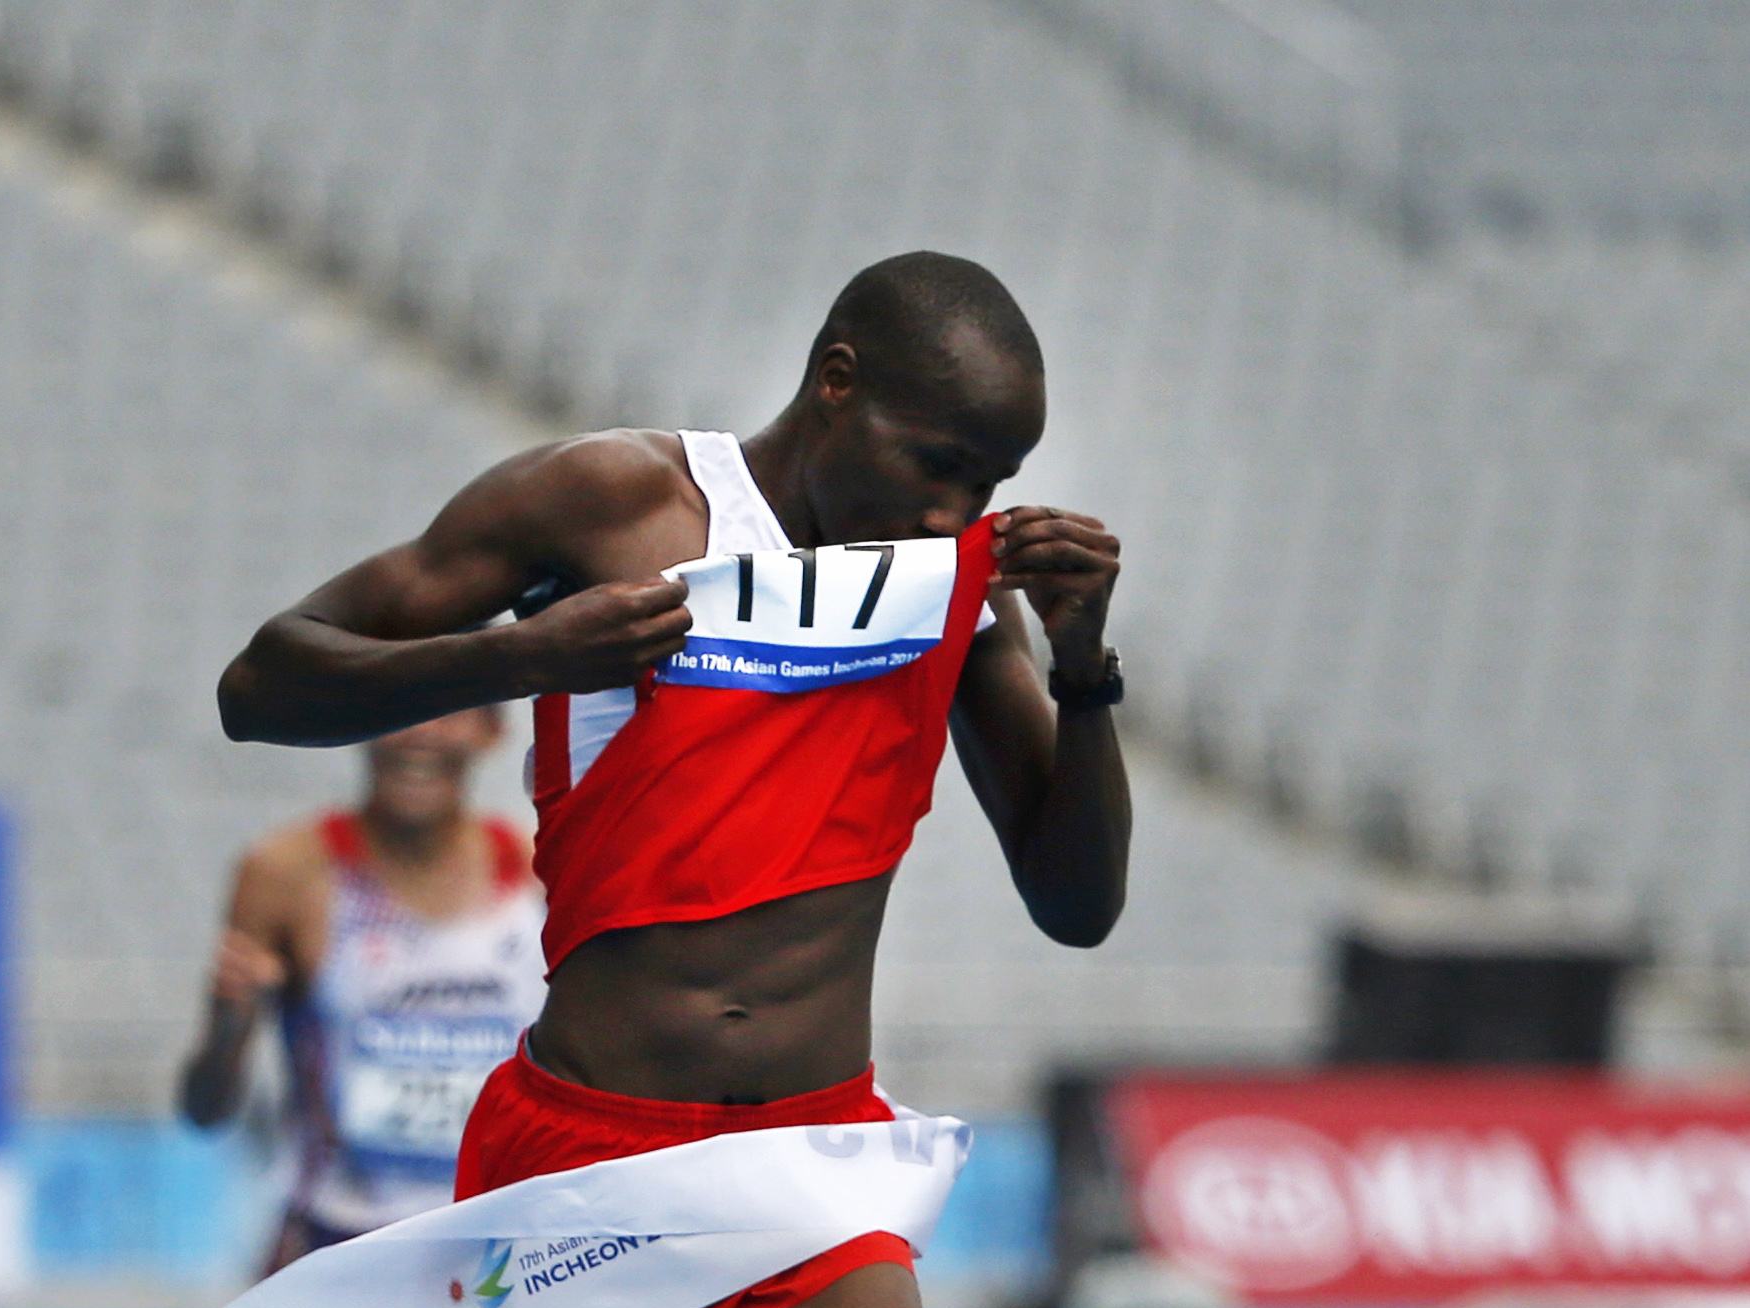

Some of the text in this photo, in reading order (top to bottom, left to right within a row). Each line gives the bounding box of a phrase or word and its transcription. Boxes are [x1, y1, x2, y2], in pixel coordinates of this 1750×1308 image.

[735, 545, 894, 630] 117
[700, 653, 731, 672] 17th
[732, 656, 777, 676] Asian
[780, 660, 830, 677] Games
[519, 1235, 589, 1271] 17th Asian
[523, 1235, 640, 1296] INCHEON
